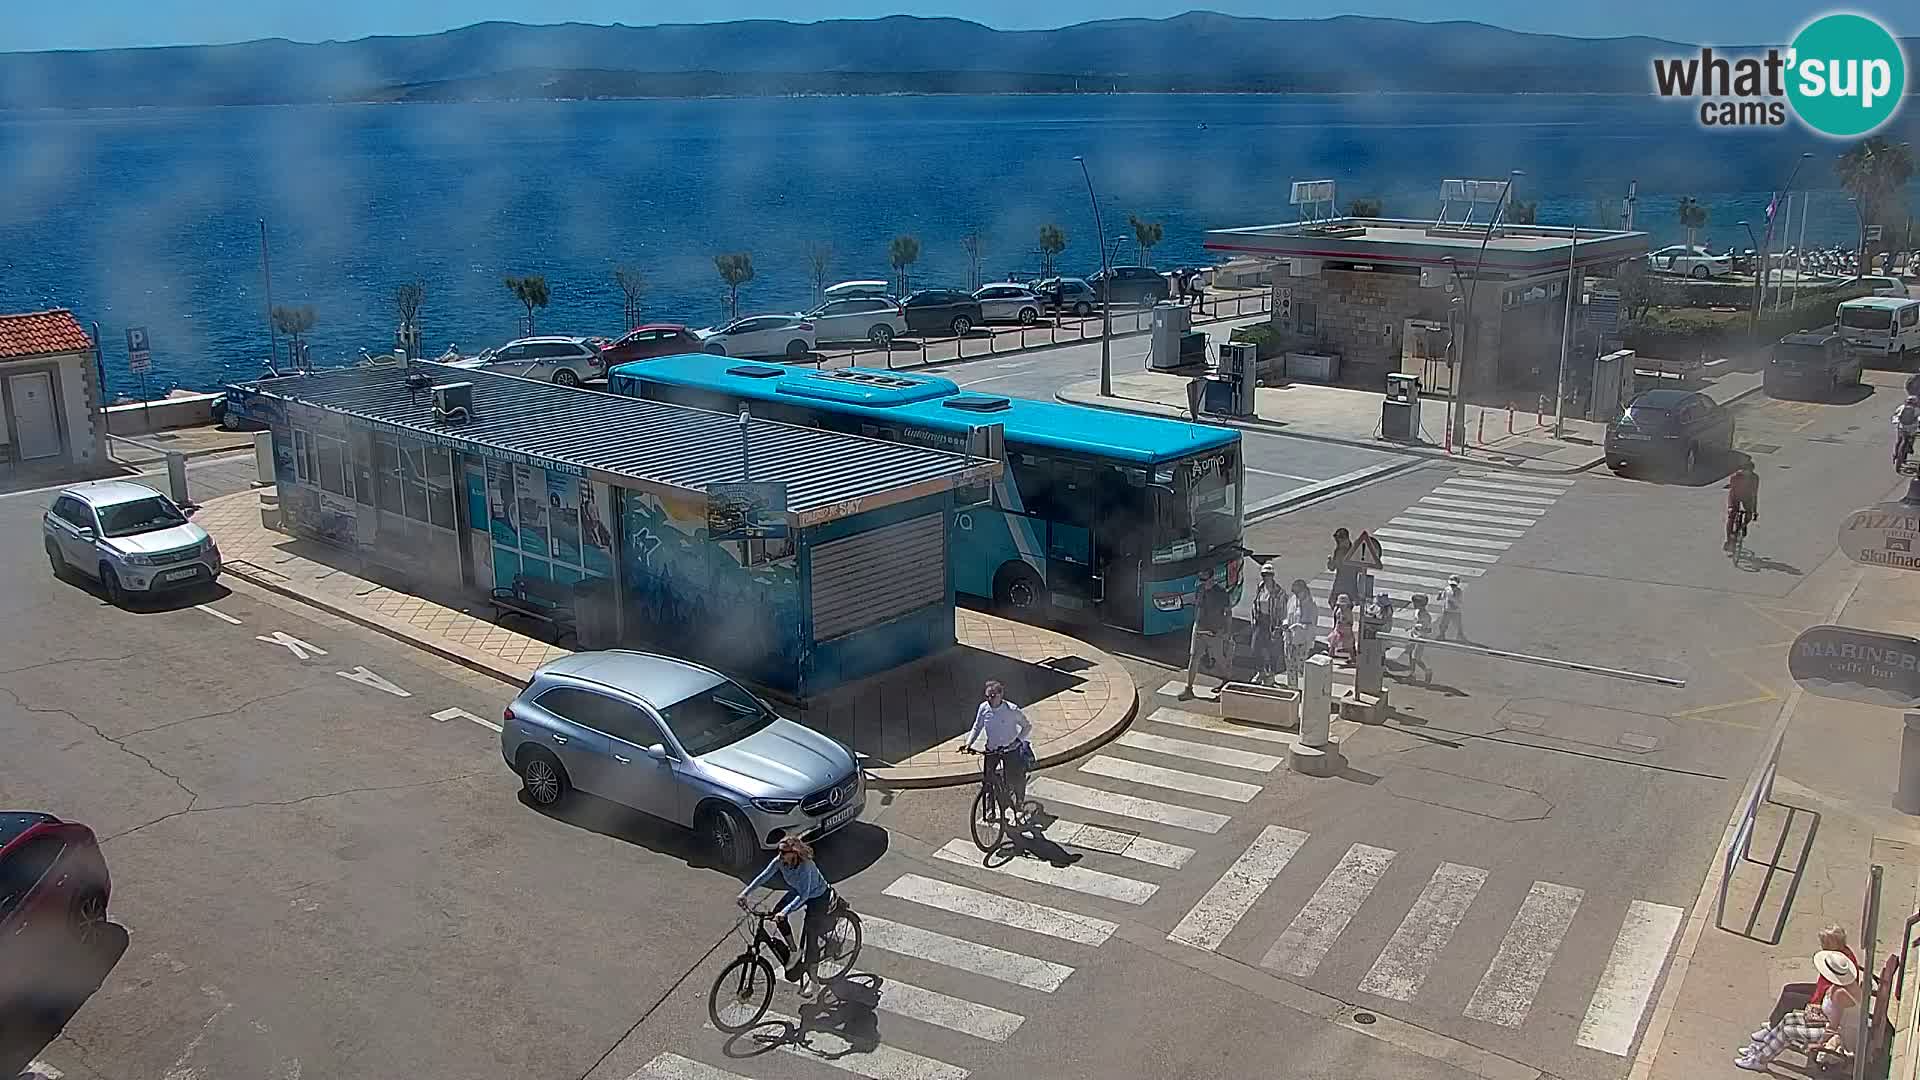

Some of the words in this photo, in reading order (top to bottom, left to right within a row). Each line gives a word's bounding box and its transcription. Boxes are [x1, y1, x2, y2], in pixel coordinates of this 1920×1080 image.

[438, 436, 468, 451] POSTAJA
[479, 446, 494, 457] BUS
[495, 450, 527, 465] STATION
[529, 456, 555, 470] TICKET
[556, 463, 583, 476] OFFICE
[1848, 511, 1920, 532] PIZZE
[1801, 640, 1920, 672] MARINER
[1871, 664, 1897, 679] bar
